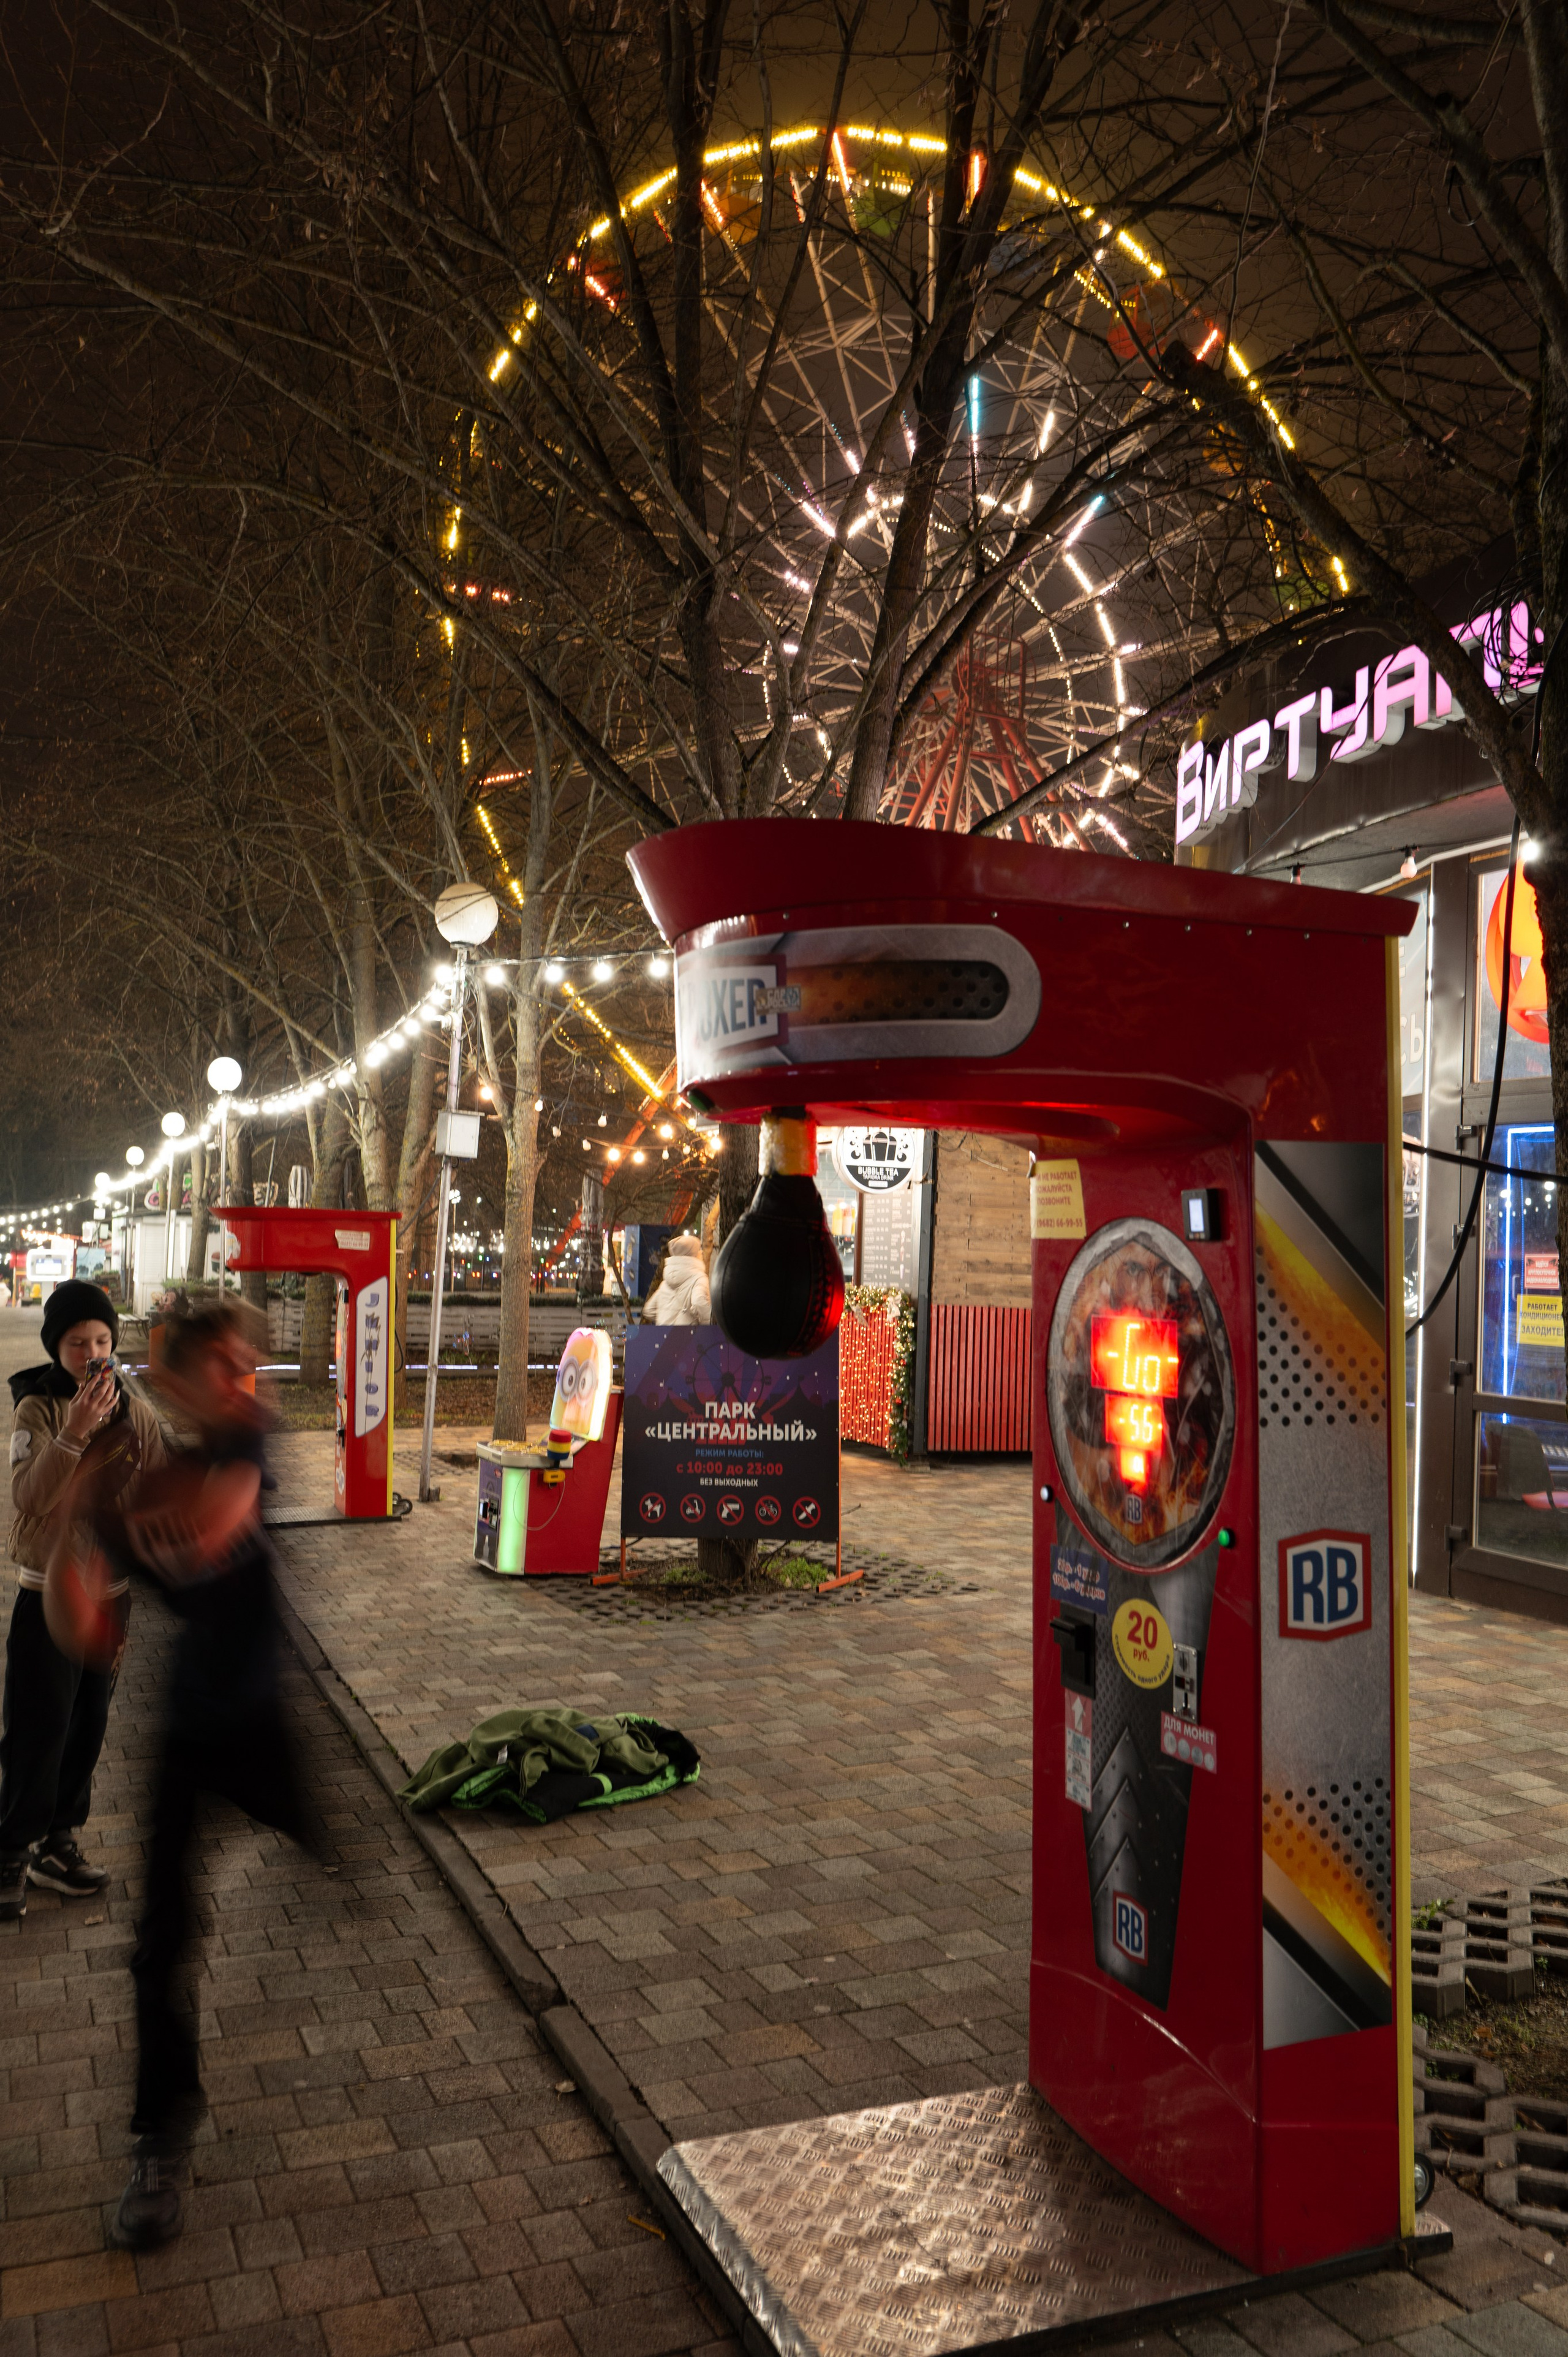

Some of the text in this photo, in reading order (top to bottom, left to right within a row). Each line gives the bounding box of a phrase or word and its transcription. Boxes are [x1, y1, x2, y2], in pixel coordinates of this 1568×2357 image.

[681, 977, 767, 1042] OXER
[858, 1166, 899, 1176] BUBBLE TEA
[1042, 1173, 1049, 1181] НЕ
[1050, 1171, 1077, 1181] РАБОТАЕТ
[1037, 1197, 1071, 1206] ПОЗВОНИТЕ
[1528, 1303, 1558, 1311] РАБОТАЕТ
[705, 1401, 756, 1420] ПАРК
[645, 1420, 817, 1442] «ЦЕНТРАЛЬНЫЙ»
[695, 1448, 764, 1458] РЕЖИМ РАБОТЫ:
[676, 1461, 783, 1477] с 10:00 до 23:00
[700, 1477, 758, 1488] БЕЗ ВЫХОДНЫХ
[1292, 1546, 1359, 1624] RB
[1127, 1610, 1158, 1650] 20
[1133, 1648, 1150, 1662] руб.
[1137, 1674, 1158, 1684] одного
[1158, 1654, 1170, 1681] удара
[1164, 1715, 1215, 1746] ДЛЯ МОНЕТ
[1118, 1902, 1143, 1954] RB
